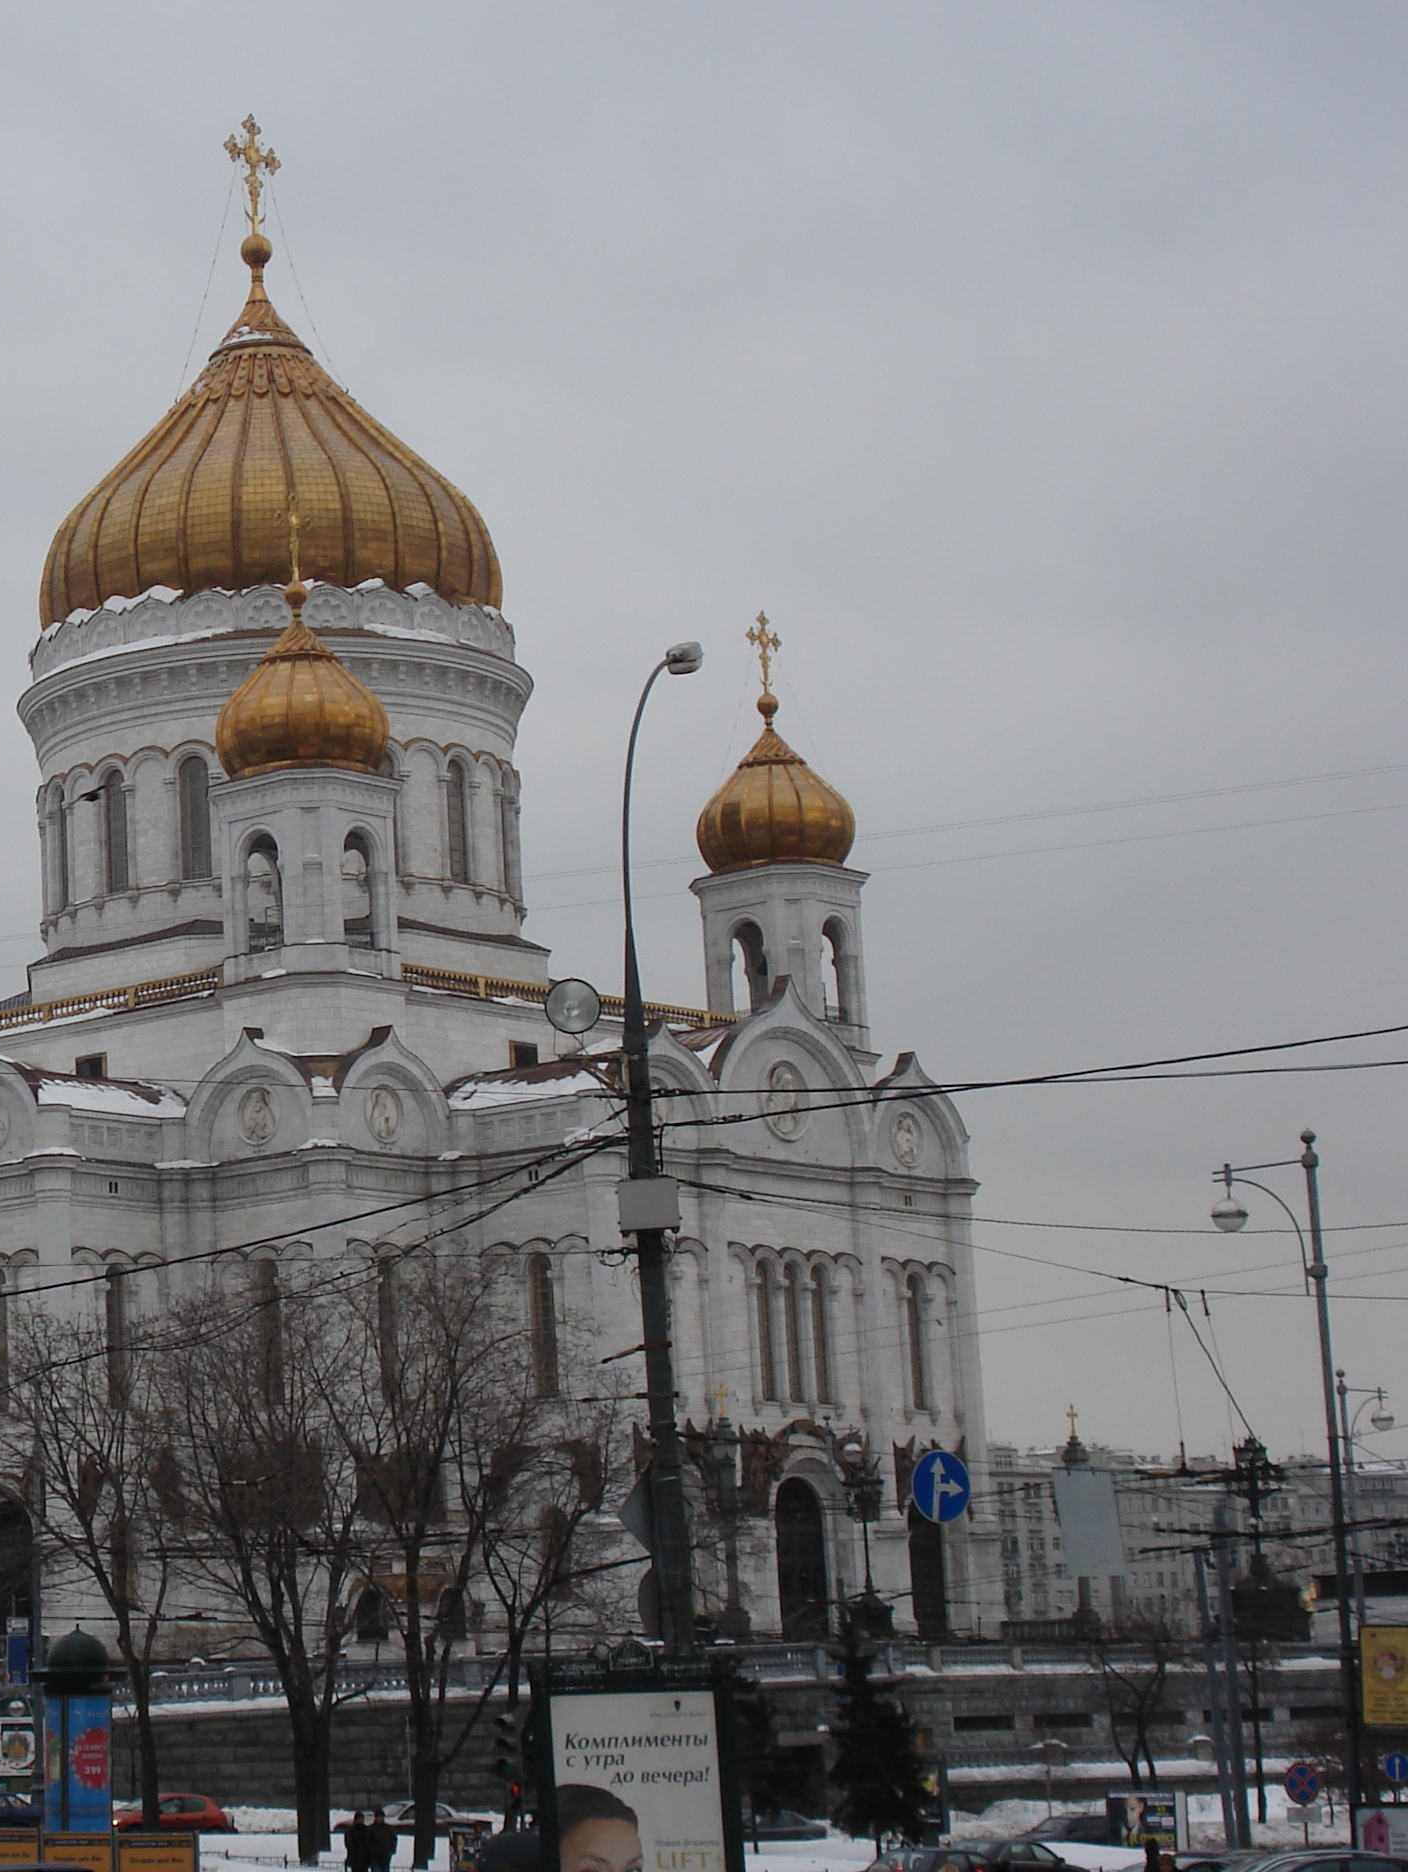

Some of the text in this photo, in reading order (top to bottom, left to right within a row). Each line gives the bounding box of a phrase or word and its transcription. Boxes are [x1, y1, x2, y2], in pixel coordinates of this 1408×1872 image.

[564, 1733, 709, 1750] Комплименты
[566, 1753, 625, 1771] с утра
[610, 1767, 710, 1787] до вечера!
